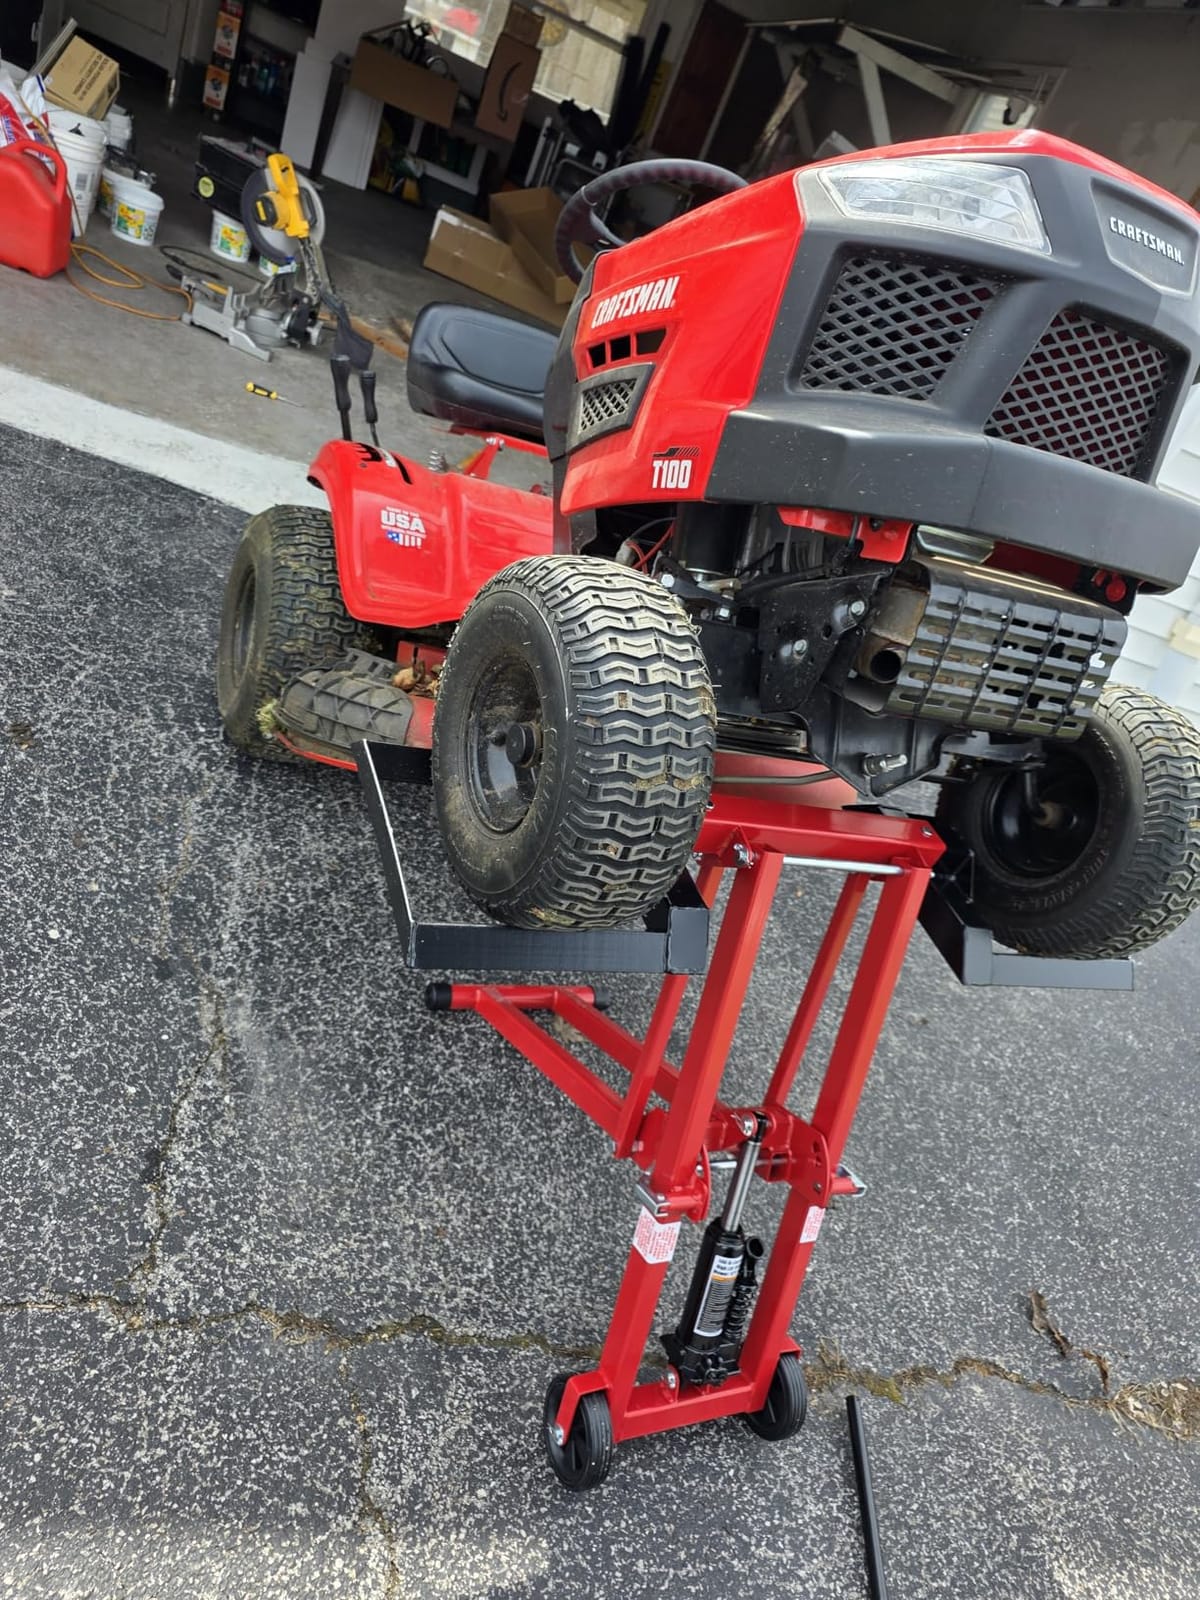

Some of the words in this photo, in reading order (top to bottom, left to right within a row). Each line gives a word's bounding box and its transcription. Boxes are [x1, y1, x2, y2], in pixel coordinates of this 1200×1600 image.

[1110, 216, 1184, 265] CRAFTSMAN
[591, 275, 680, 329] CRAFTSMAN
[652, 459, 692, 489] T100
[381, 509, 426, 534] USA
